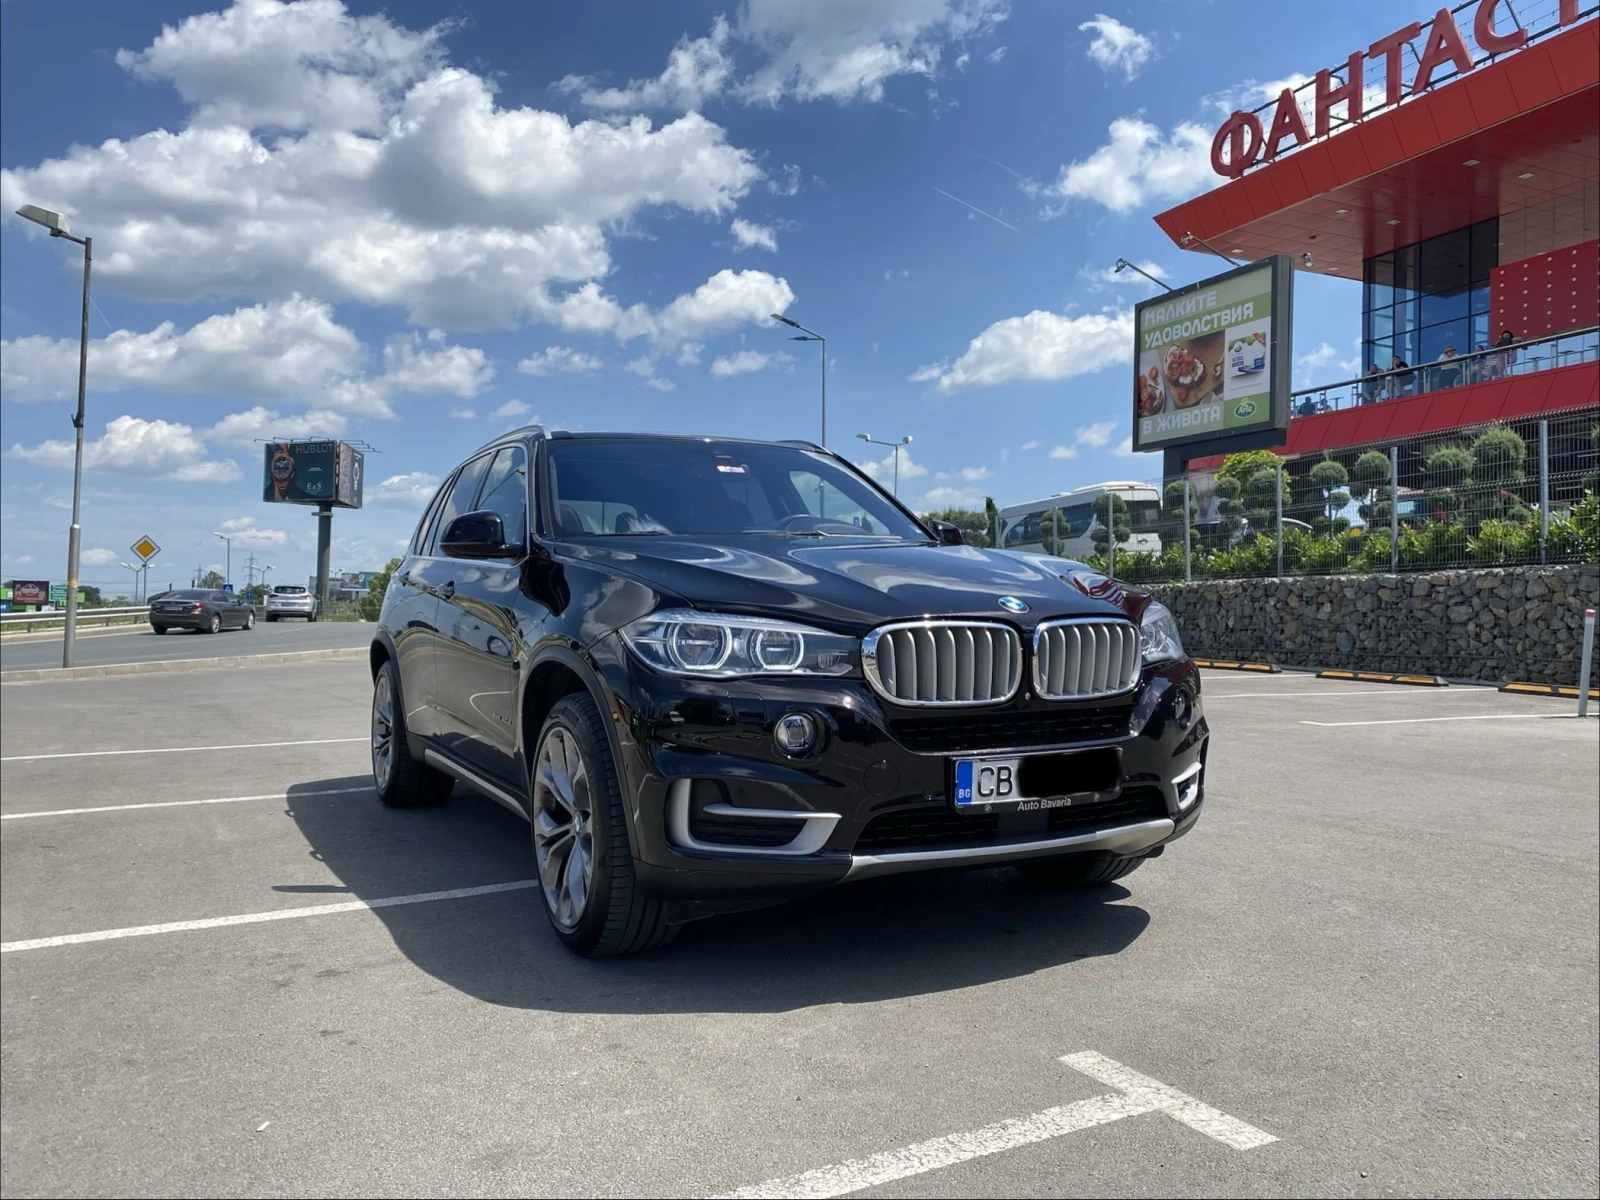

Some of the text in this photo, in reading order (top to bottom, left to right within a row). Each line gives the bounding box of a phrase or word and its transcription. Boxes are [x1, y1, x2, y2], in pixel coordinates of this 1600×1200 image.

[1145, 291, 1217, 327] МАЛКИТЕ
[1145, 302, 1254, 348] УДОВОЛСТВИЯ
[1143, 405, 1221, 435] В ЖИВОТА
[1238, 405, 1252, 414] Arla
[296, 444, 333, 453] HUBLOT
[958, 766, 1013, 798] BG CB
[1017, 796, 1072, 812] Auto Bavaria
